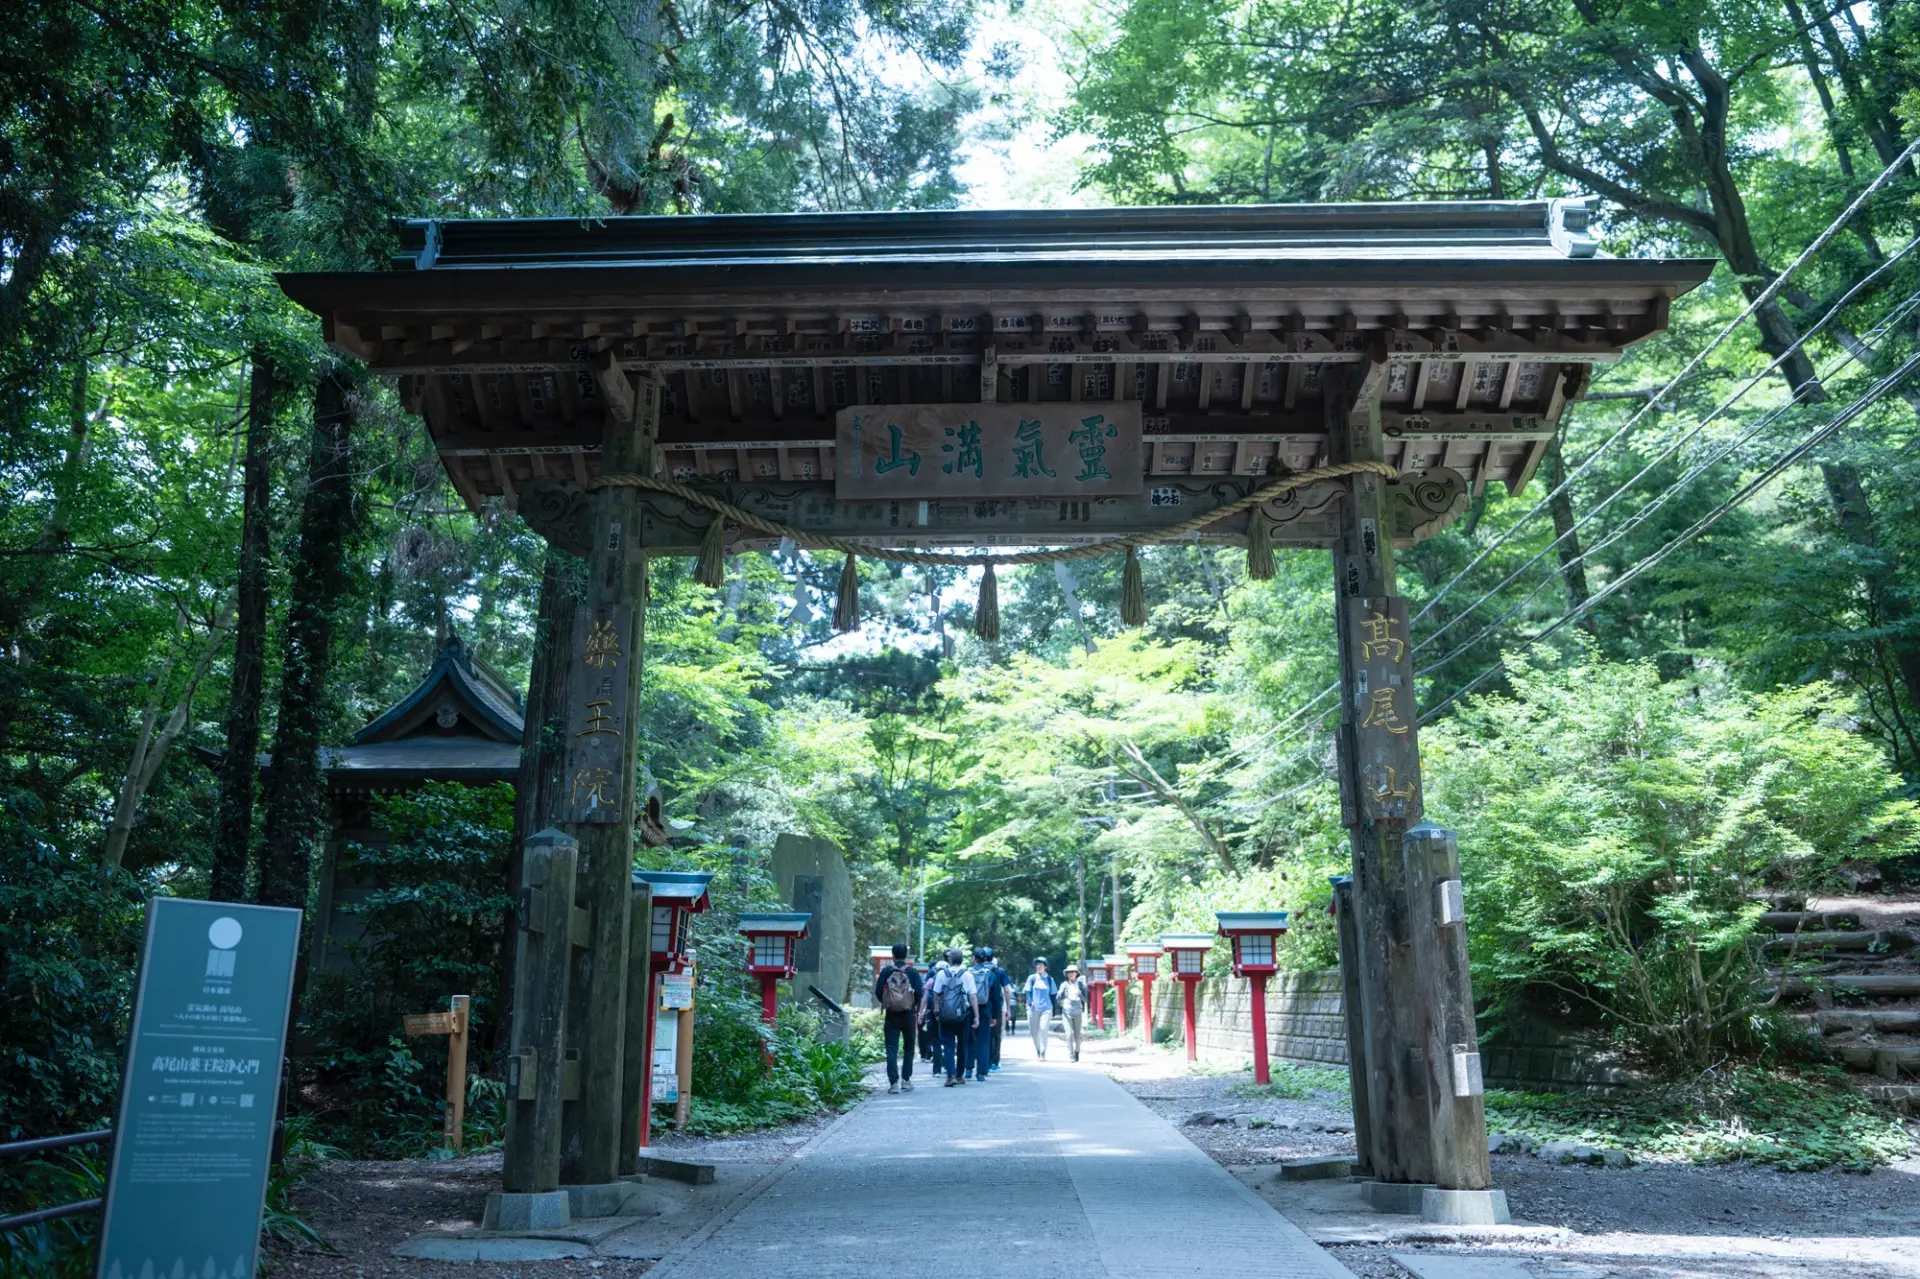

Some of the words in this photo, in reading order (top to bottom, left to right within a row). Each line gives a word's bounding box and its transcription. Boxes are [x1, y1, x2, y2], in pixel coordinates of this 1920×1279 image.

[152, 1056, 260, 1075] 高尾山薬王院浄心門
